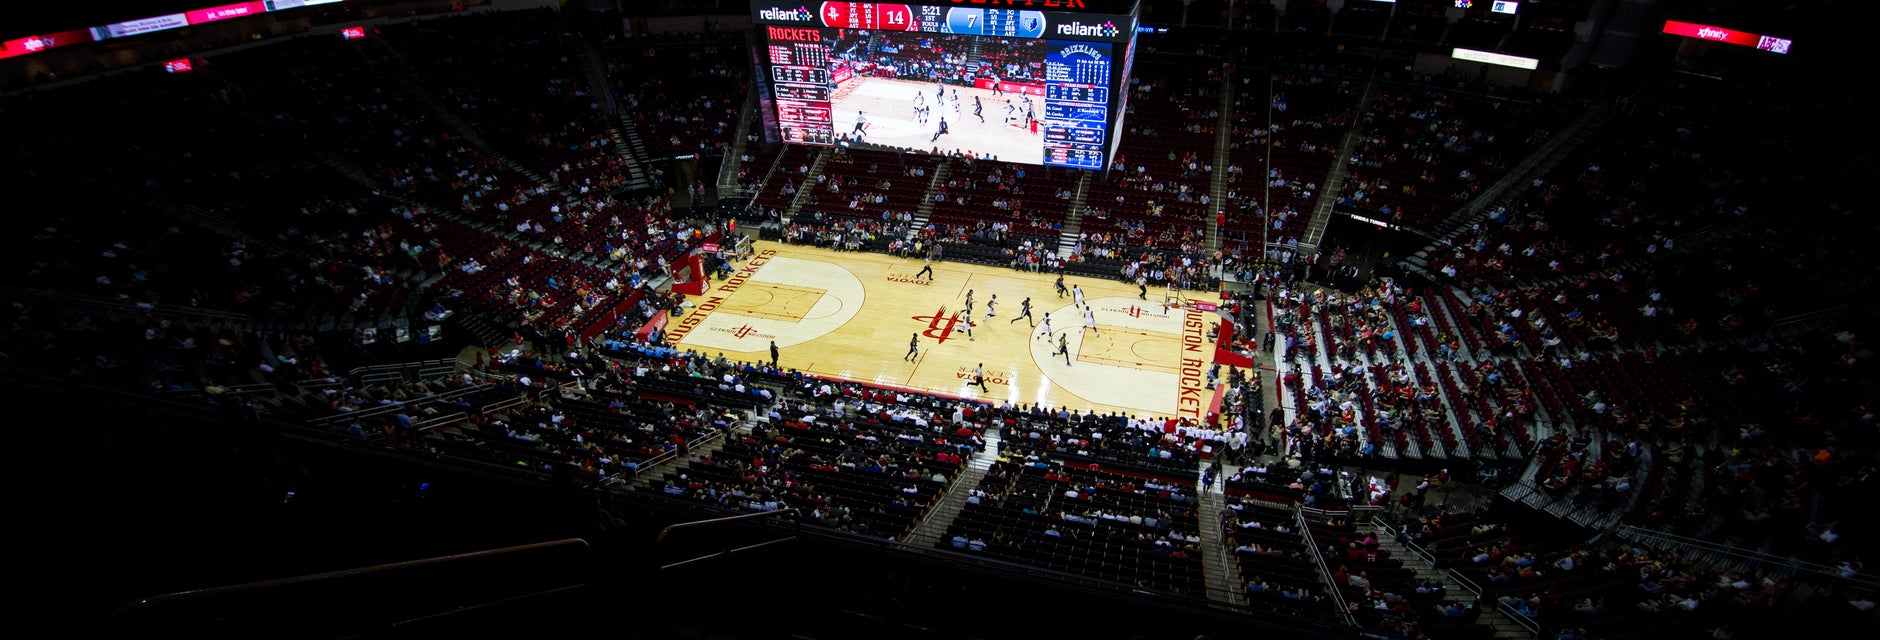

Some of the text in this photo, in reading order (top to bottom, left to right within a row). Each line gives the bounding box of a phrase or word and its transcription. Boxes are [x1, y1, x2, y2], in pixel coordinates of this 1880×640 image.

[760, 7, 800, 22] reliant
[922, 6, 941, 15] 5:21
[886, 11, 904, 25] 14
[967, 14, 977, 28] 7
[768, 26, 821, 42] ROCKETS
[1057, 21, 1103, 37] reliant
[1697, 28, 1728, 41] xfinity
[1060, 44, 1102, 61] GRIZZLIES
[1350, 214, 1369, 223] TUNDRA
[1369, 218, 1388, 228] TUNNEL
[887, 276, 930, 286] TOYOTA
[667, 248, 777, 343] OUSTON ROCKETS
